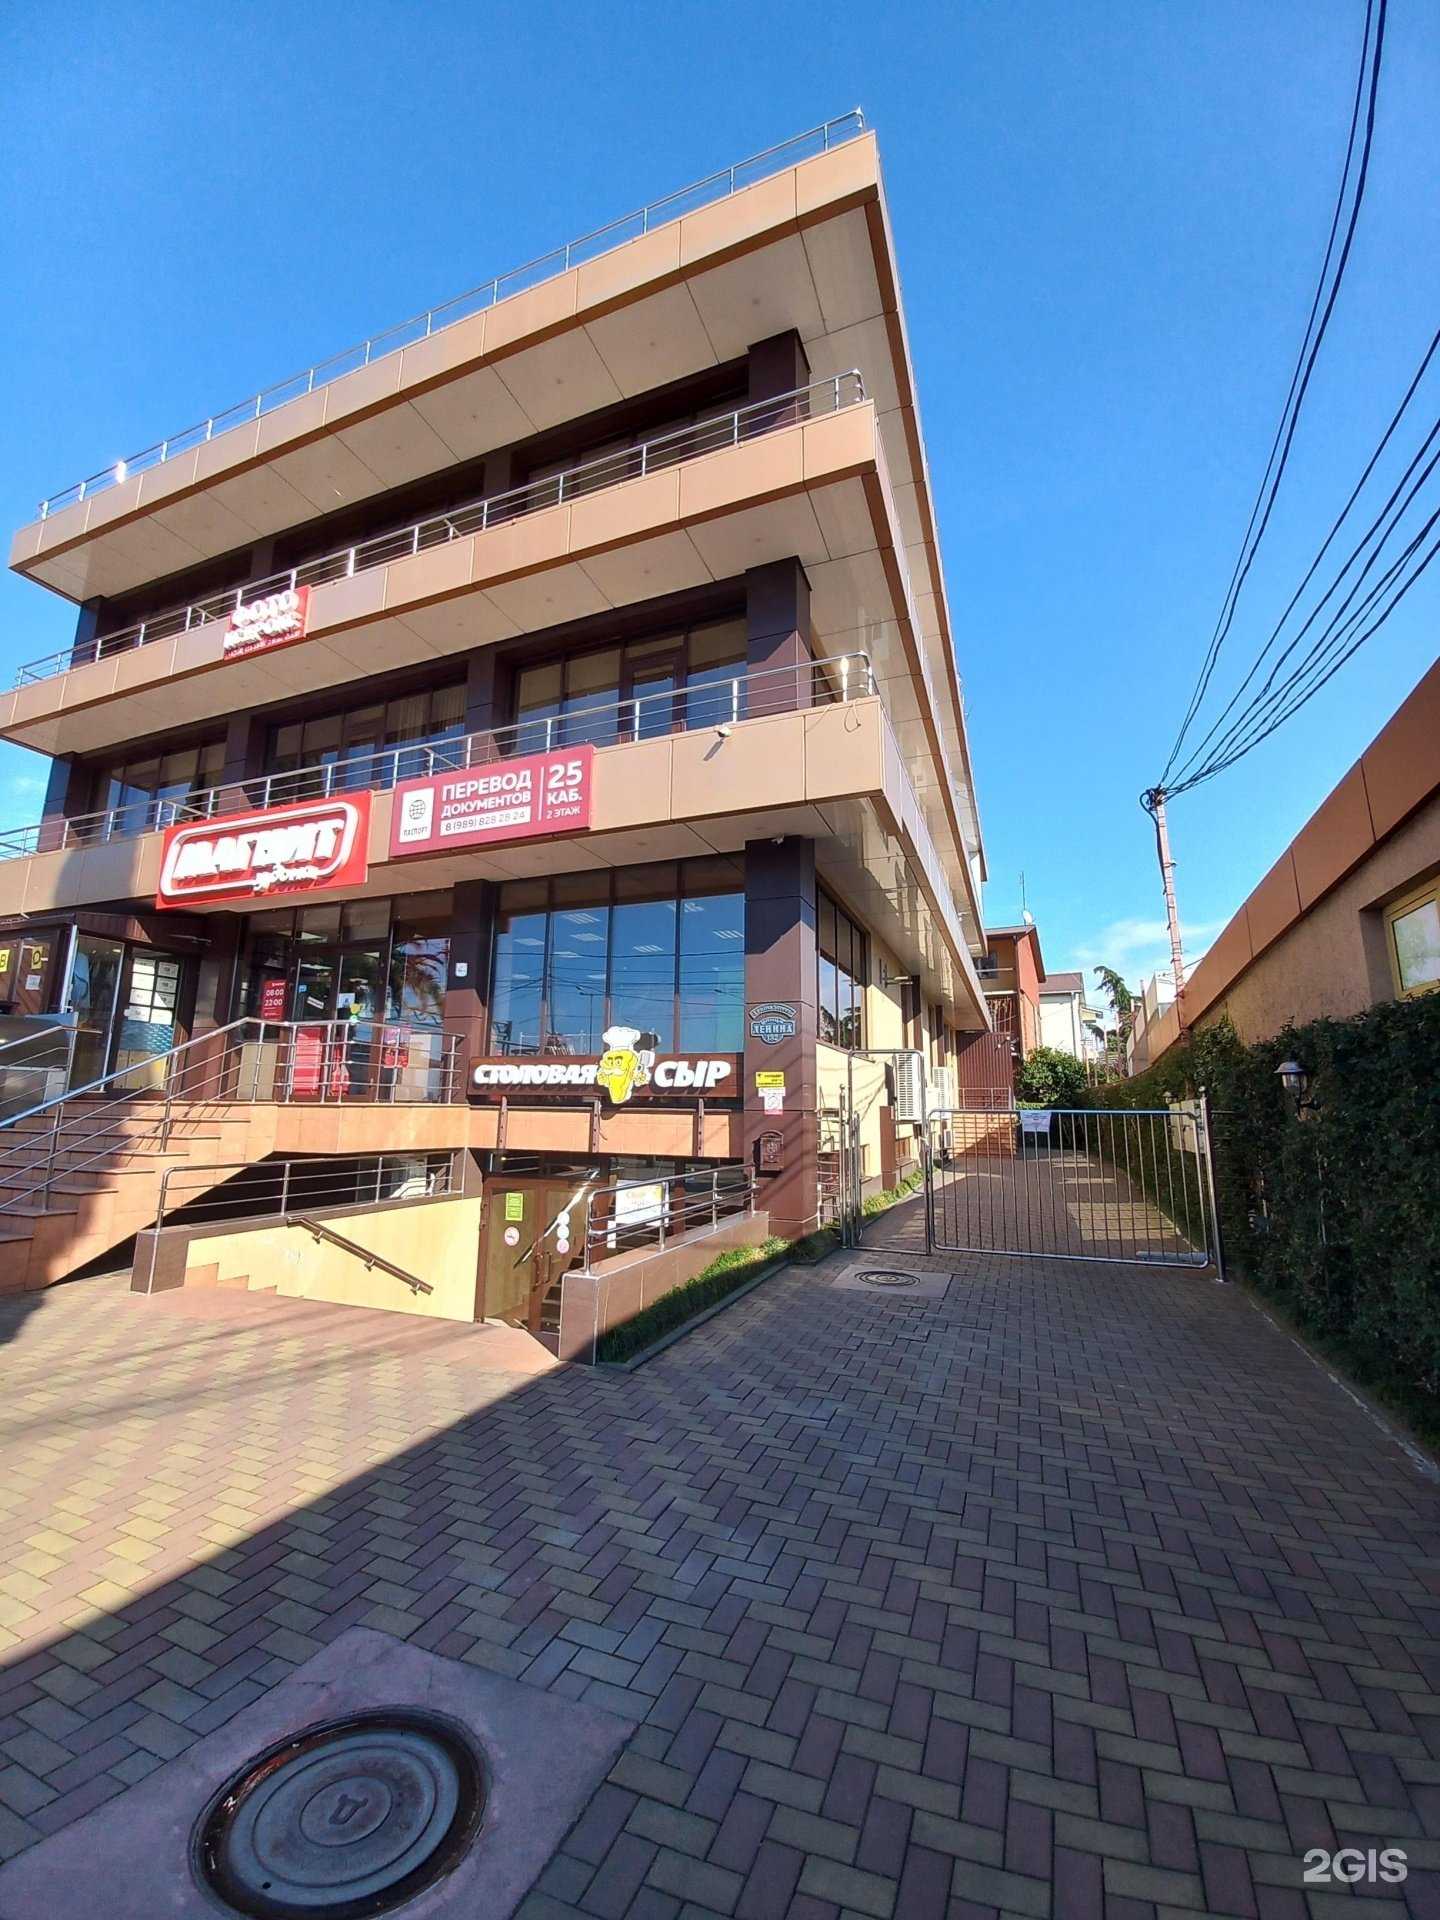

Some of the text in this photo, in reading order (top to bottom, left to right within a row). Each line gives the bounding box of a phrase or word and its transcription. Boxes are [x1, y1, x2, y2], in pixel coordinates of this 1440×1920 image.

[442, 760, 583, 801] ПЕРЕВОД 25
[440, 789, 582, 819] ДОКУМЕНТОВ КАБ.
[546, 807, 581, 819] 2 ЭТАЖ
[752, 1023, 793, 1034] ЛЕНИНА
[474, 1064, 598, 1085] СТОЛОВАЯ
[654, 1060, 732, 1088] СЫР
